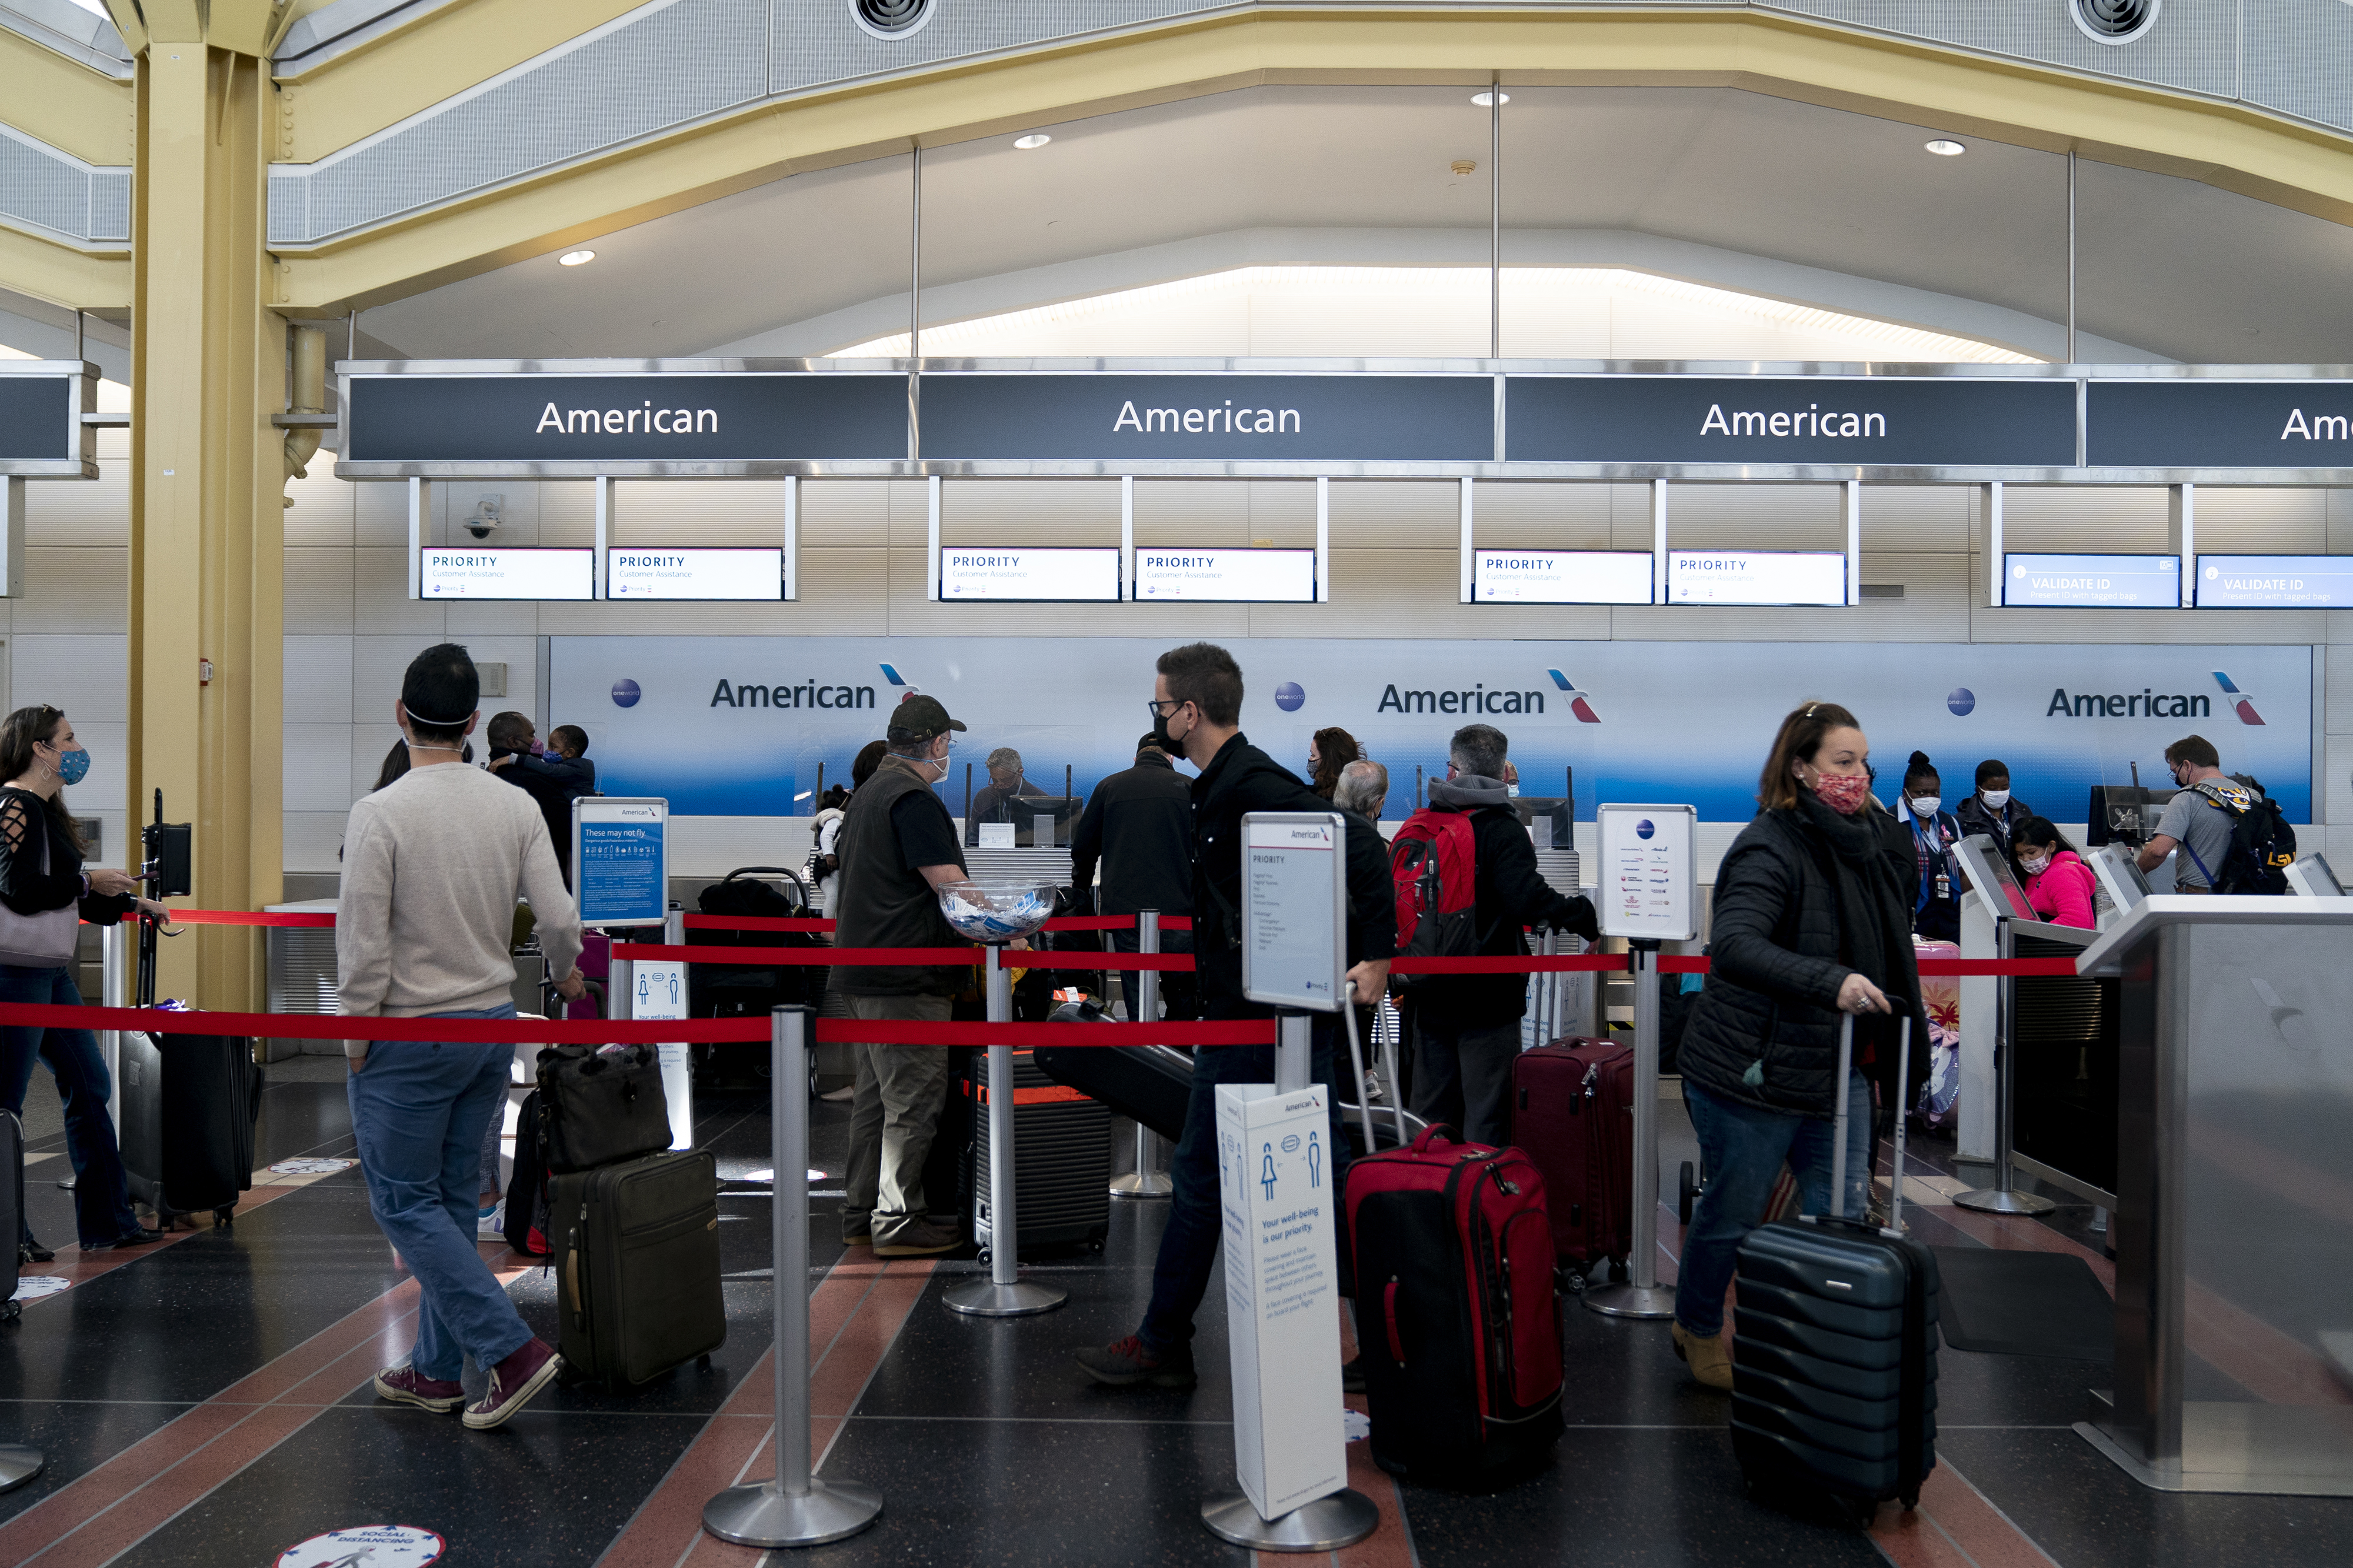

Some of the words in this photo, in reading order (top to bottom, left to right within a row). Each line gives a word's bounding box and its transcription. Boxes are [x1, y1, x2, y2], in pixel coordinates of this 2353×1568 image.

[536, 401, 718, 433] American
[1113, 400, 1300, 432] American
[1700, 404, 1885, 436] American
[2281, 408, 2353, 440] Am
[433, 557, 497, 566] PRIORITY
[620, 557, 685, 566] PRIORITY
[954, 557, 1020, 566] PRIORITY
[1148, 558, 1214, 567] PRIORITY
[1487, 559, 1554, 569] PRIORITY
[1681, 561, 1746, 570] PRIORITY
[2032, 578, 2093, 589] VALIDATE
[2097, 579, 2110, 589] ID
[2224, 579, 2286, 589] VALIDATE
[2290, 580, 2304, 590] ID
[2091, 592, 2117, 601] tagged
[2120, 592, 2137, 601] bags
[2284, 593, 2310, 602] tagged
[2313, 593, 2331, 602] bags
[711, 679, 875, 708] American
[1378, 683, 1544, 713] American
[2047, 689, 2210, 717] American
[636, 829, 646, 838] fly.
[1291, 830, 1319, 838] American
[1253, 855, 1284, 863] PRIORITY
[1285, 1100, 1311, 1112] American
[1262, 1218, 1279, 1229] Your
[1281, 1207, 1318, 1223] well-being
[1263, 1235, 1269, 1244] is
[1271, 1232, 1283, 1241] our
[1285, 1223, 1312, 1240] priority.
[1264, 1255, 1279, 1263] Please
[1264, 1263, 1285, 1273] covering
[1265, 1275, 1278, 1283] space
[1279, 1268, 1300, 1278] between
[1301, 1263, 1317, 1272] others
[1265, 1279, 1292, 1293] throughout
[1294, 1276, 1304, 1285] your
[1282, 1293, 1302, 1304] covering
[1308, 1283, 1327, 1295] required
[1274, 1307, 1288, 1316] board
[1289, 1303, 1299, 1312] your
